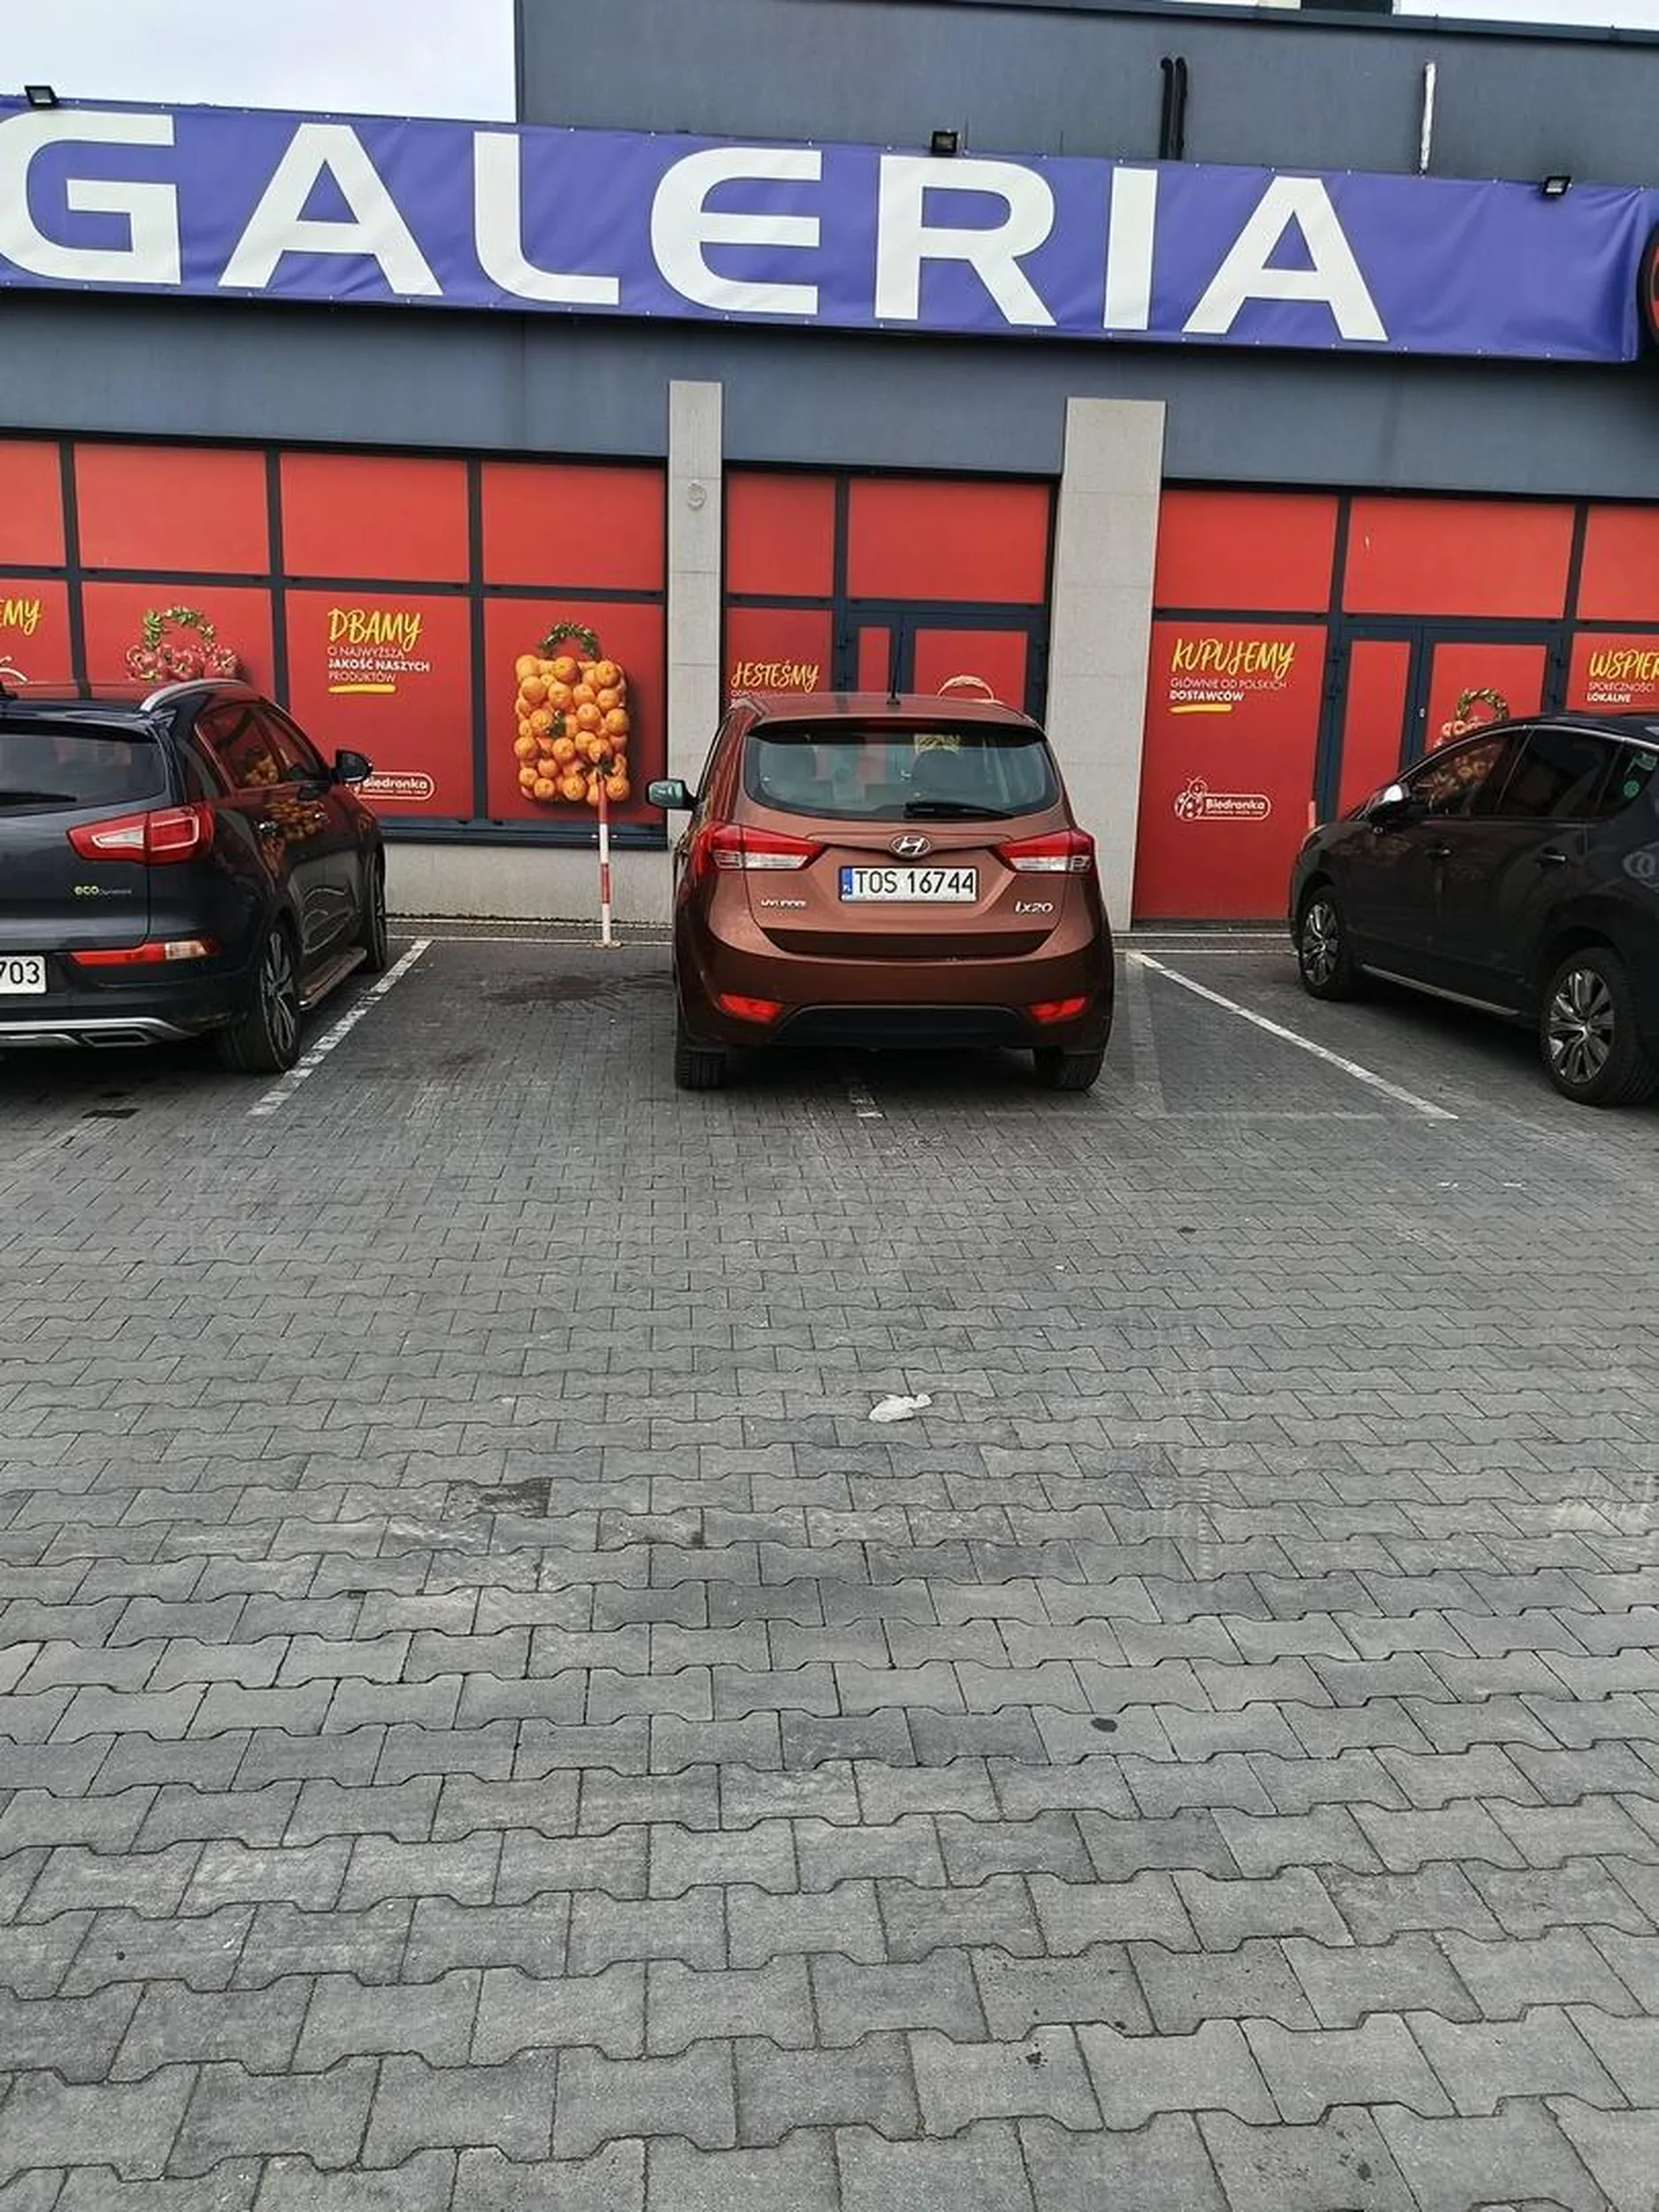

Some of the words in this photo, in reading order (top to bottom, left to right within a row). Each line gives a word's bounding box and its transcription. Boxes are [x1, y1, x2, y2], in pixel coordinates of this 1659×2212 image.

[0, 109, 1389, 343] GALERIA
[327, 608, 423, 652] DBAMY
[327, 646, 337, 656] O
[328, 657, 373, 670] JAKOŚĆ
[375, 659, 429, 672] NASZYCH
[1171, 638, 1295, 680] KUPUJEMY
[328, 672, 396, 682] PRODUKTÓW
[731, 659, 819, 693] JESTEŚMY
[1170, 677, 1218, 688] GŁÓWNIE
[1220, 680, 1238, 688] OD
[1240, 680, 1287, 690] POLSKICH
[1169, 688, 1244, 702] DOSTAWCÓW
[1586, 693, 1632, 703] LOKALNE
[1206, 798, 1265, 810] Biedronka
[855, 871, 897, 894] TOS
[907, 871, 974, 894] 16744
